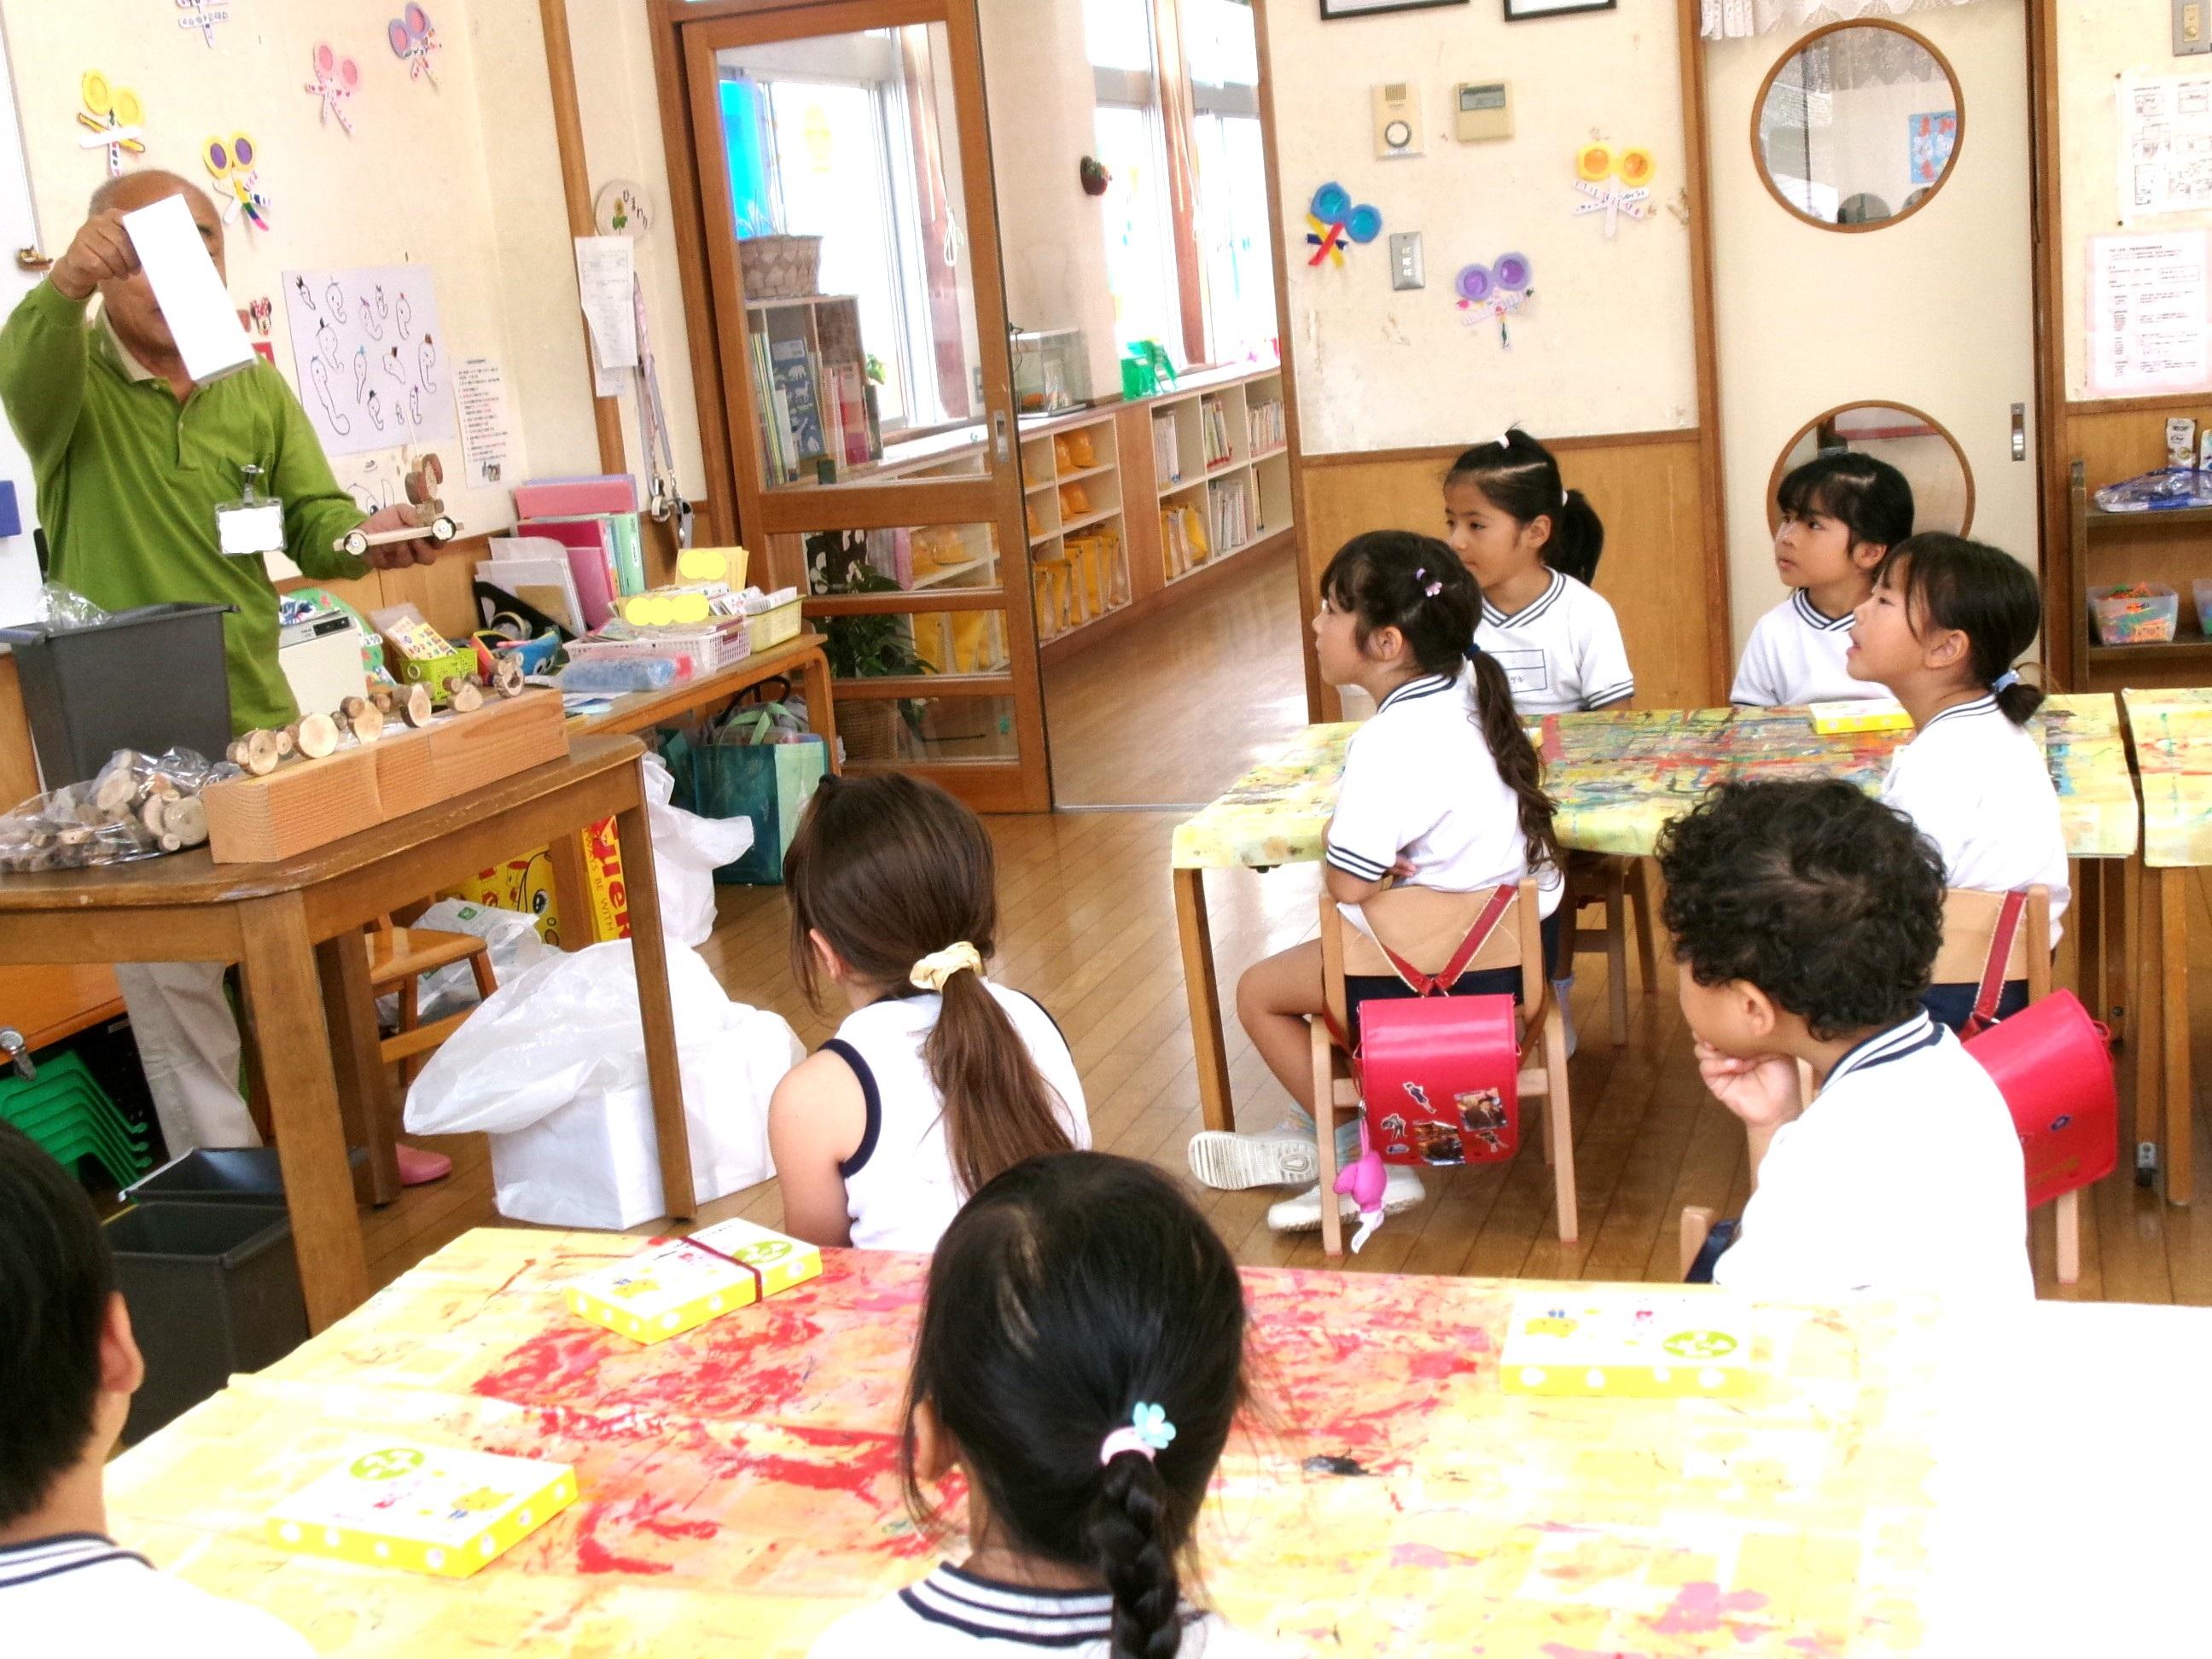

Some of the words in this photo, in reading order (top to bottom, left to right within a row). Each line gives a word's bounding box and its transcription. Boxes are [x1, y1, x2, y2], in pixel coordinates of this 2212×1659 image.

[623, 189, 648, 229] ひまわり
[595, 877, 603, 892] BE
[601, 897, 615, 932] WITH
